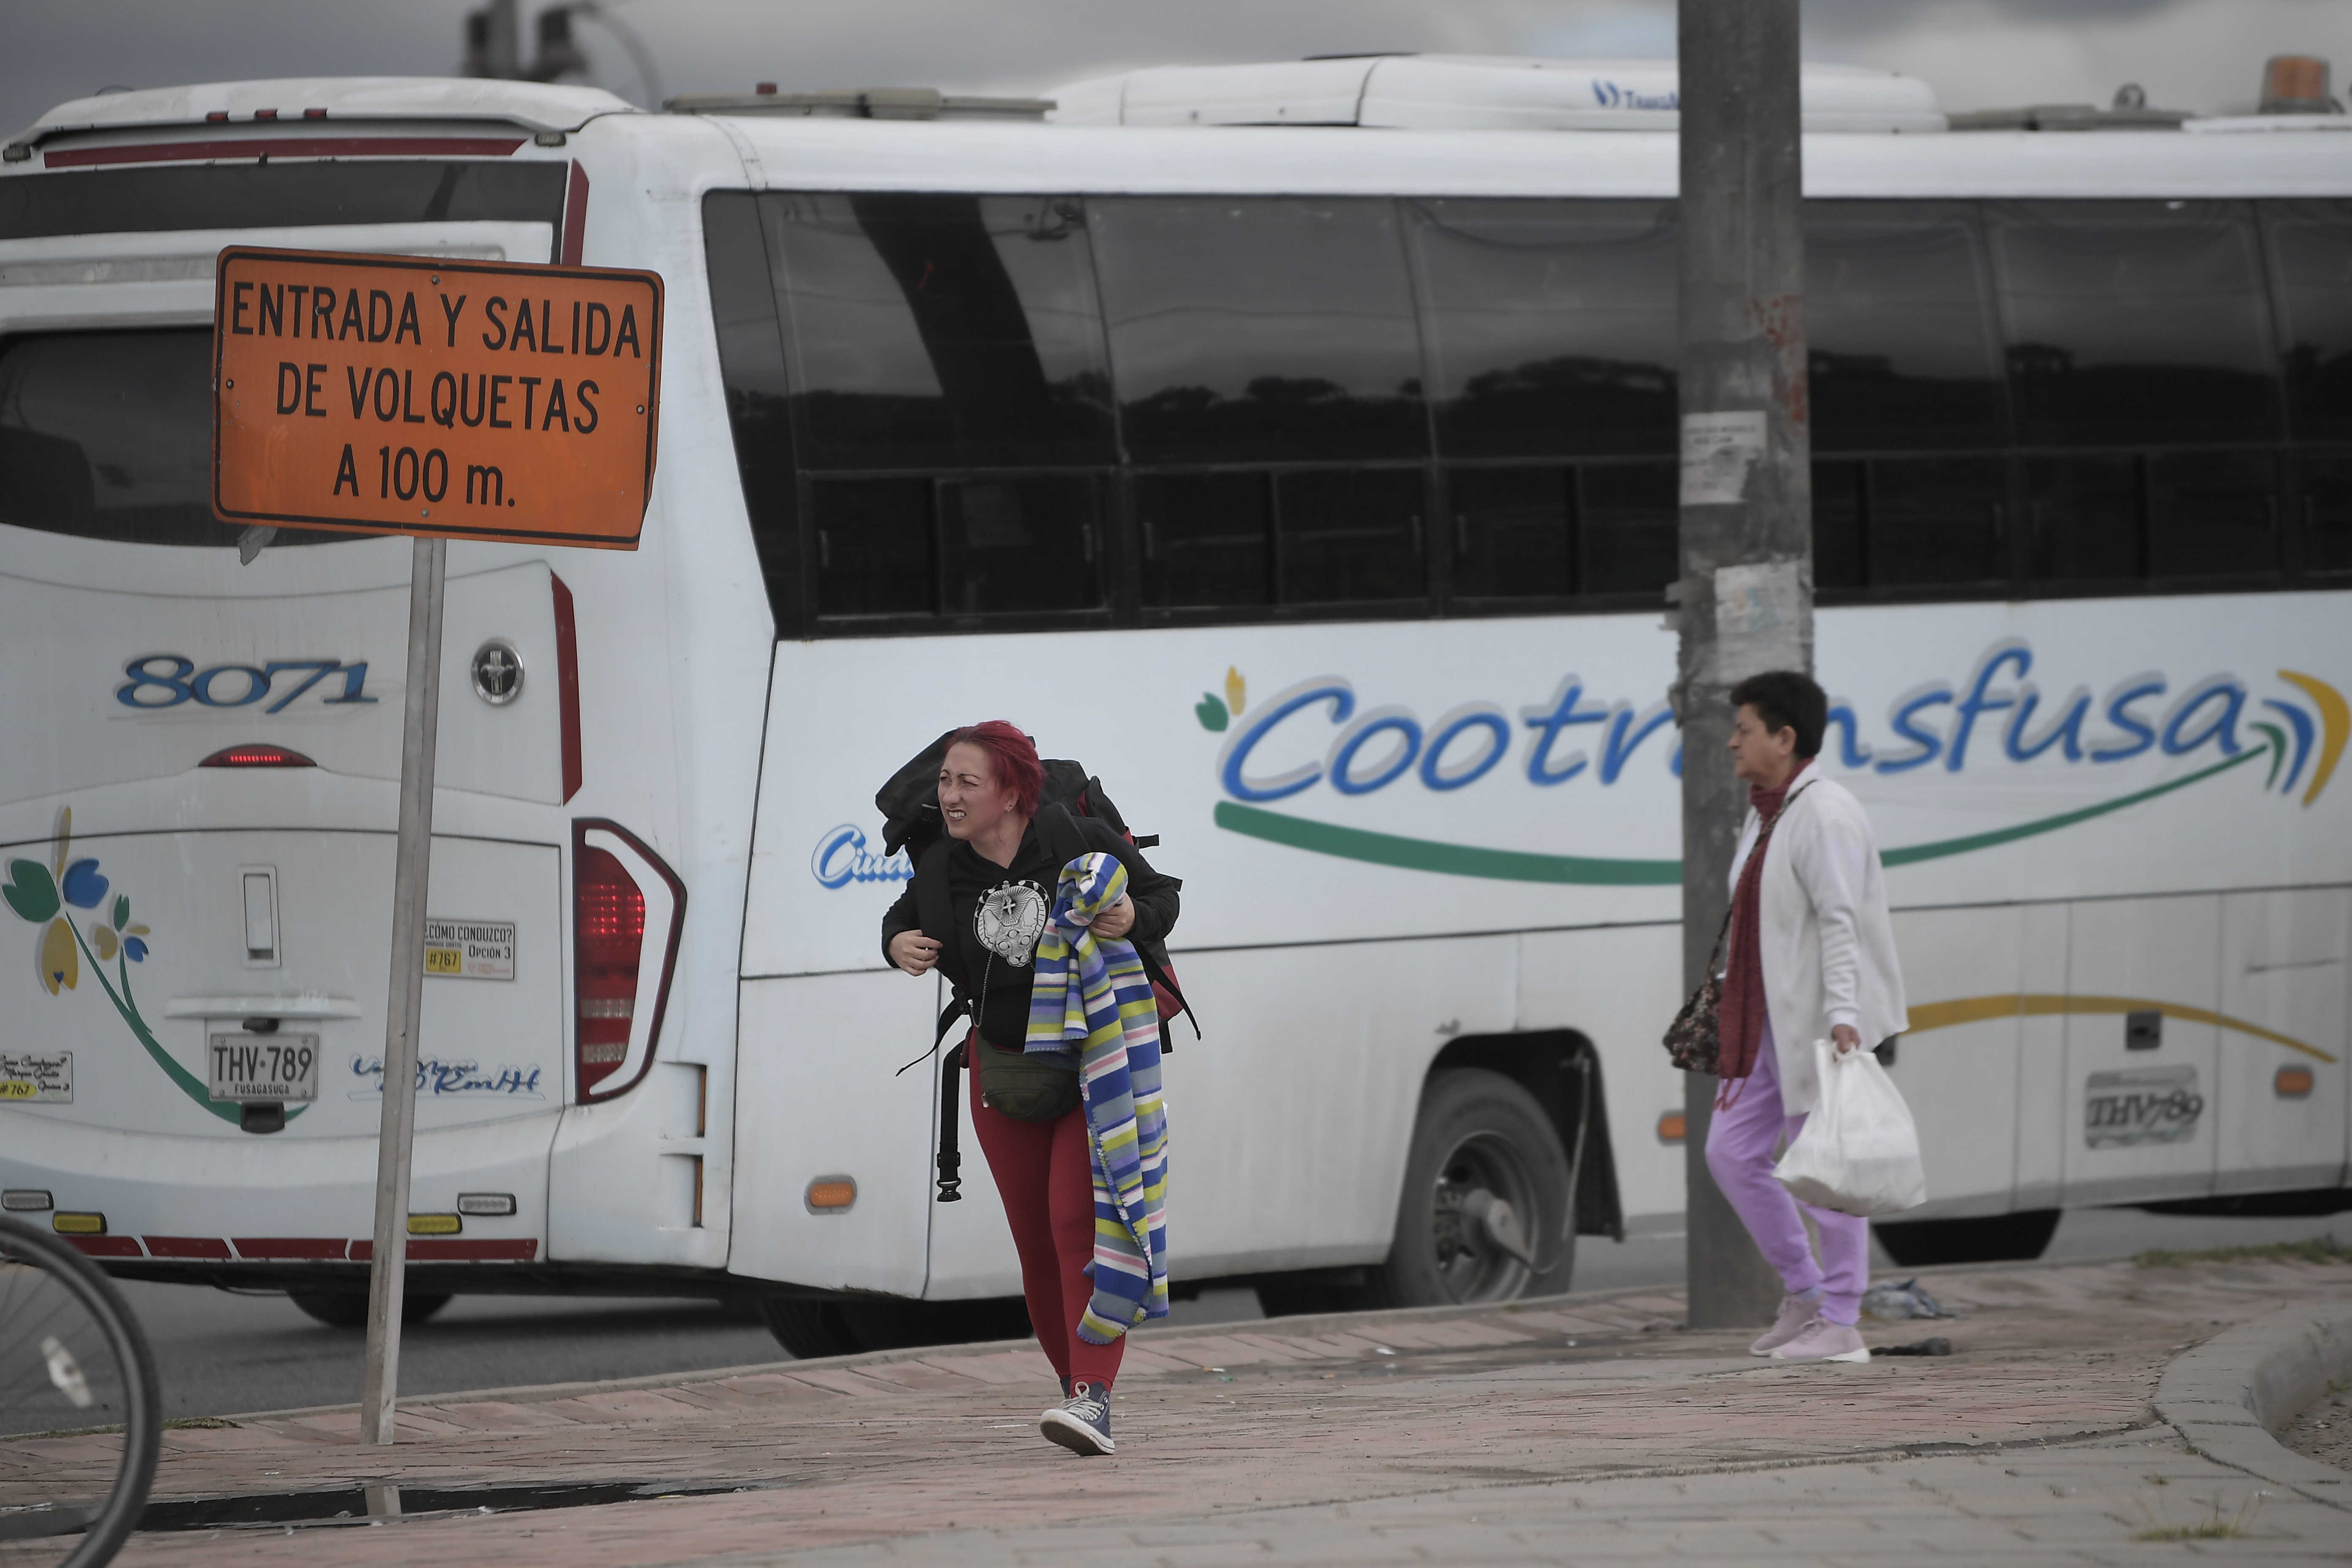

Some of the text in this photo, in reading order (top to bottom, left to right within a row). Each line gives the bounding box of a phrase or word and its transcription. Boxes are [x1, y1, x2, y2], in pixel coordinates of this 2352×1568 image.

[231, 282, 641, 358] ENTRADA Y SALIDA
[277, 361, 599, 433] DE VOLQUETAS
[333, 444, 515, 506] A 100 m.
[117, 655, 378, 713] 8071
[811, 824, 915, 890] Ciud
[504, 946, 511, 959] 3
[2087, 1089, 2205, 1129] THV789
